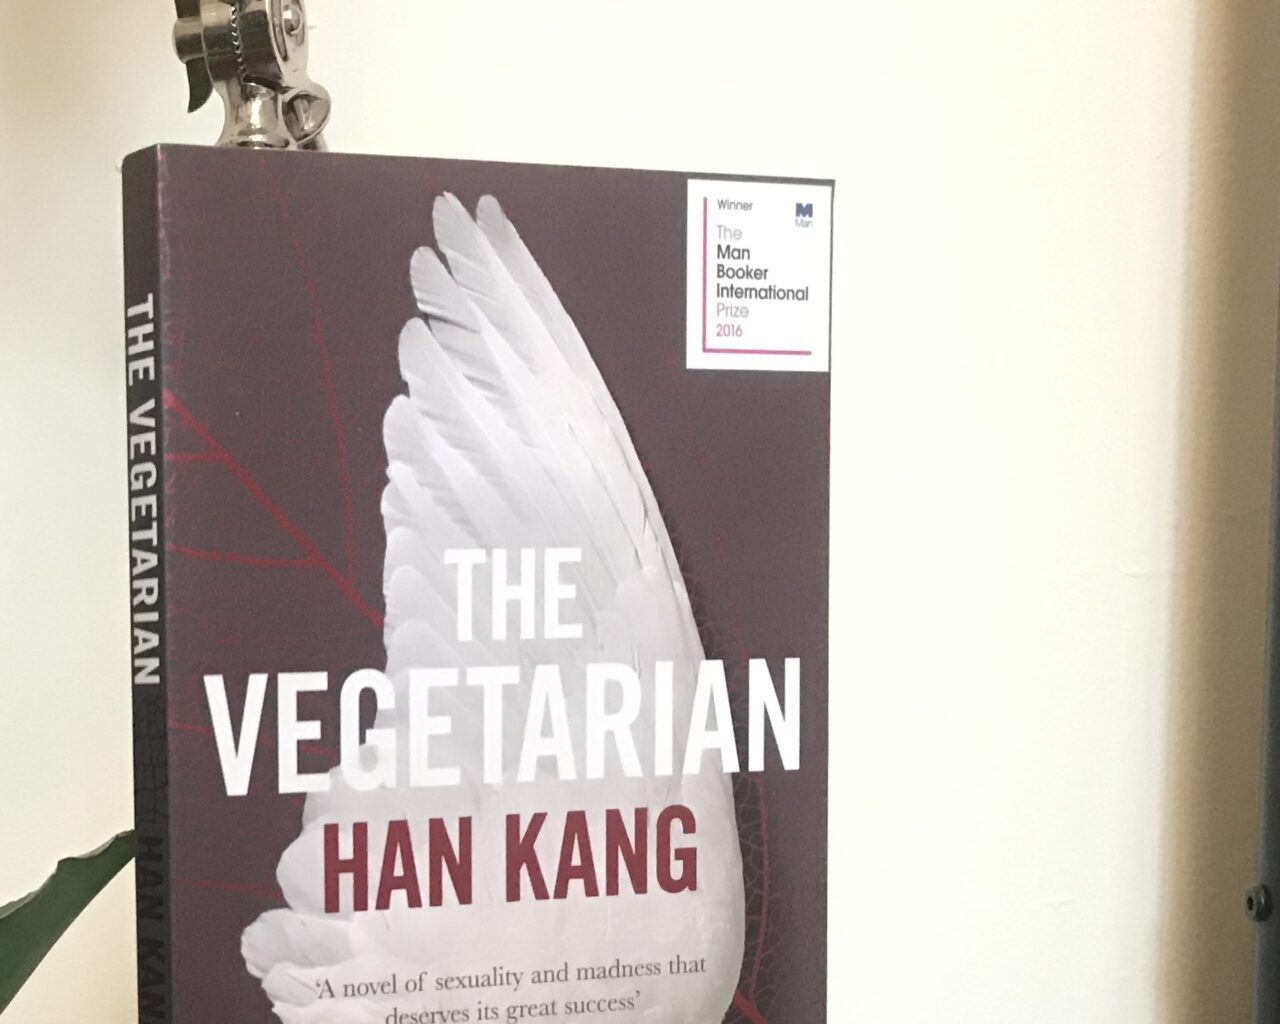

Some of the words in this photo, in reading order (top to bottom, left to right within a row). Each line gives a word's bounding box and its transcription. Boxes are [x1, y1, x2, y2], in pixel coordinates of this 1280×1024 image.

[717, 199, 753, 211] Winner
[716, 224, 742, 240] The
[716, 244, 750, 260] Man
[716, 264, 768, 280] Booker
[716, 283, 809, 301] International
[716, 303, 749, 318] Prize
[127, 293, 155, 386] THE
[716, 324, 743, 337] 2016
[129, 399, 161, 685] VEGETARIAN
[444, 547, 583, 642] THE
[203, 657, 801, 797] VEGETARIAN
[322, 815, 473, 914] HAN
[505, 804, 698, 904] KANG
[137, 836, 164, 921] HAN
[343, 974, 398, 998] novel
[404, 971, 429, 993] of
[435, 966, 524, 996] sexuality
[530, 962, 569, 984] and
[576, 958, 662, 981] madness
[668, 954, 707, 975] that
[477, 1000, 499, 1022] its
[506, 1000, 557, 1024] great
